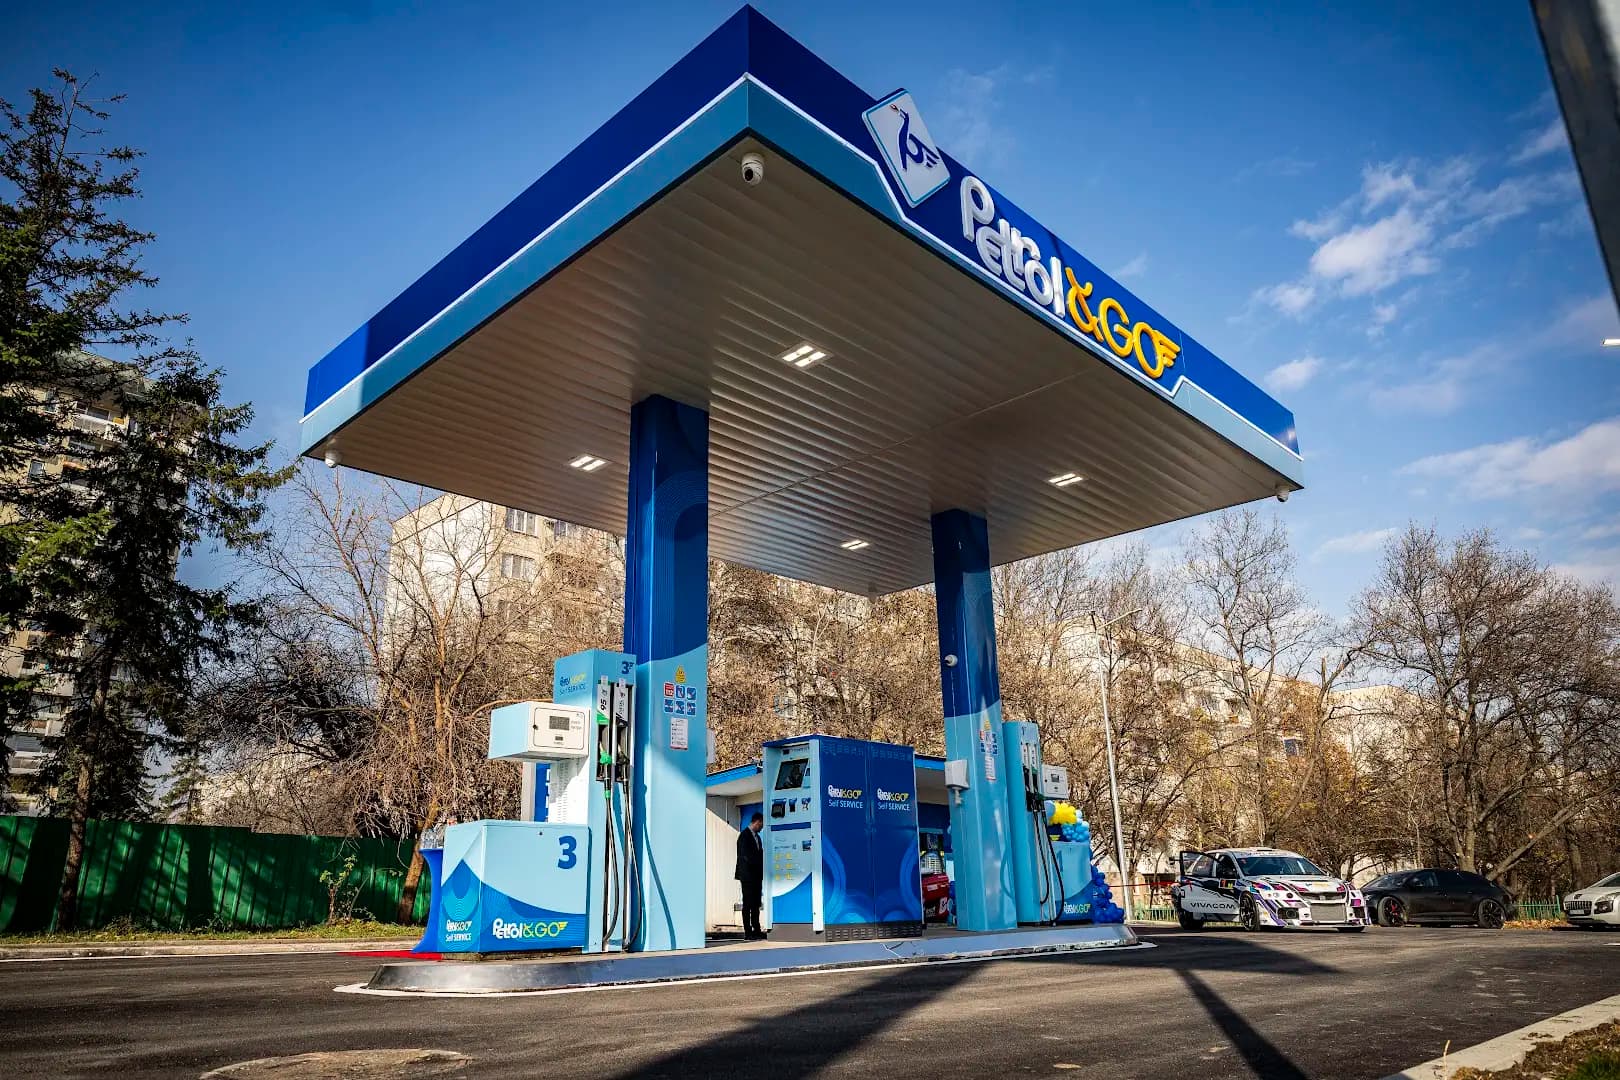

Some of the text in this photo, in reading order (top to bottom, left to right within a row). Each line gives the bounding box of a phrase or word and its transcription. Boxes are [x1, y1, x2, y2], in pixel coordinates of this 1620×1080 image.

[622, 661, 630, 674] 3
[828, 799, 864, 809] Self SERVICE
[878, 802, 911, 811] Self SERVICE
[557, 835, 578, 870] 3
[1190, 902, 1237, 910] VIVACOM
[454, 932, 472, 941] SERVICE
